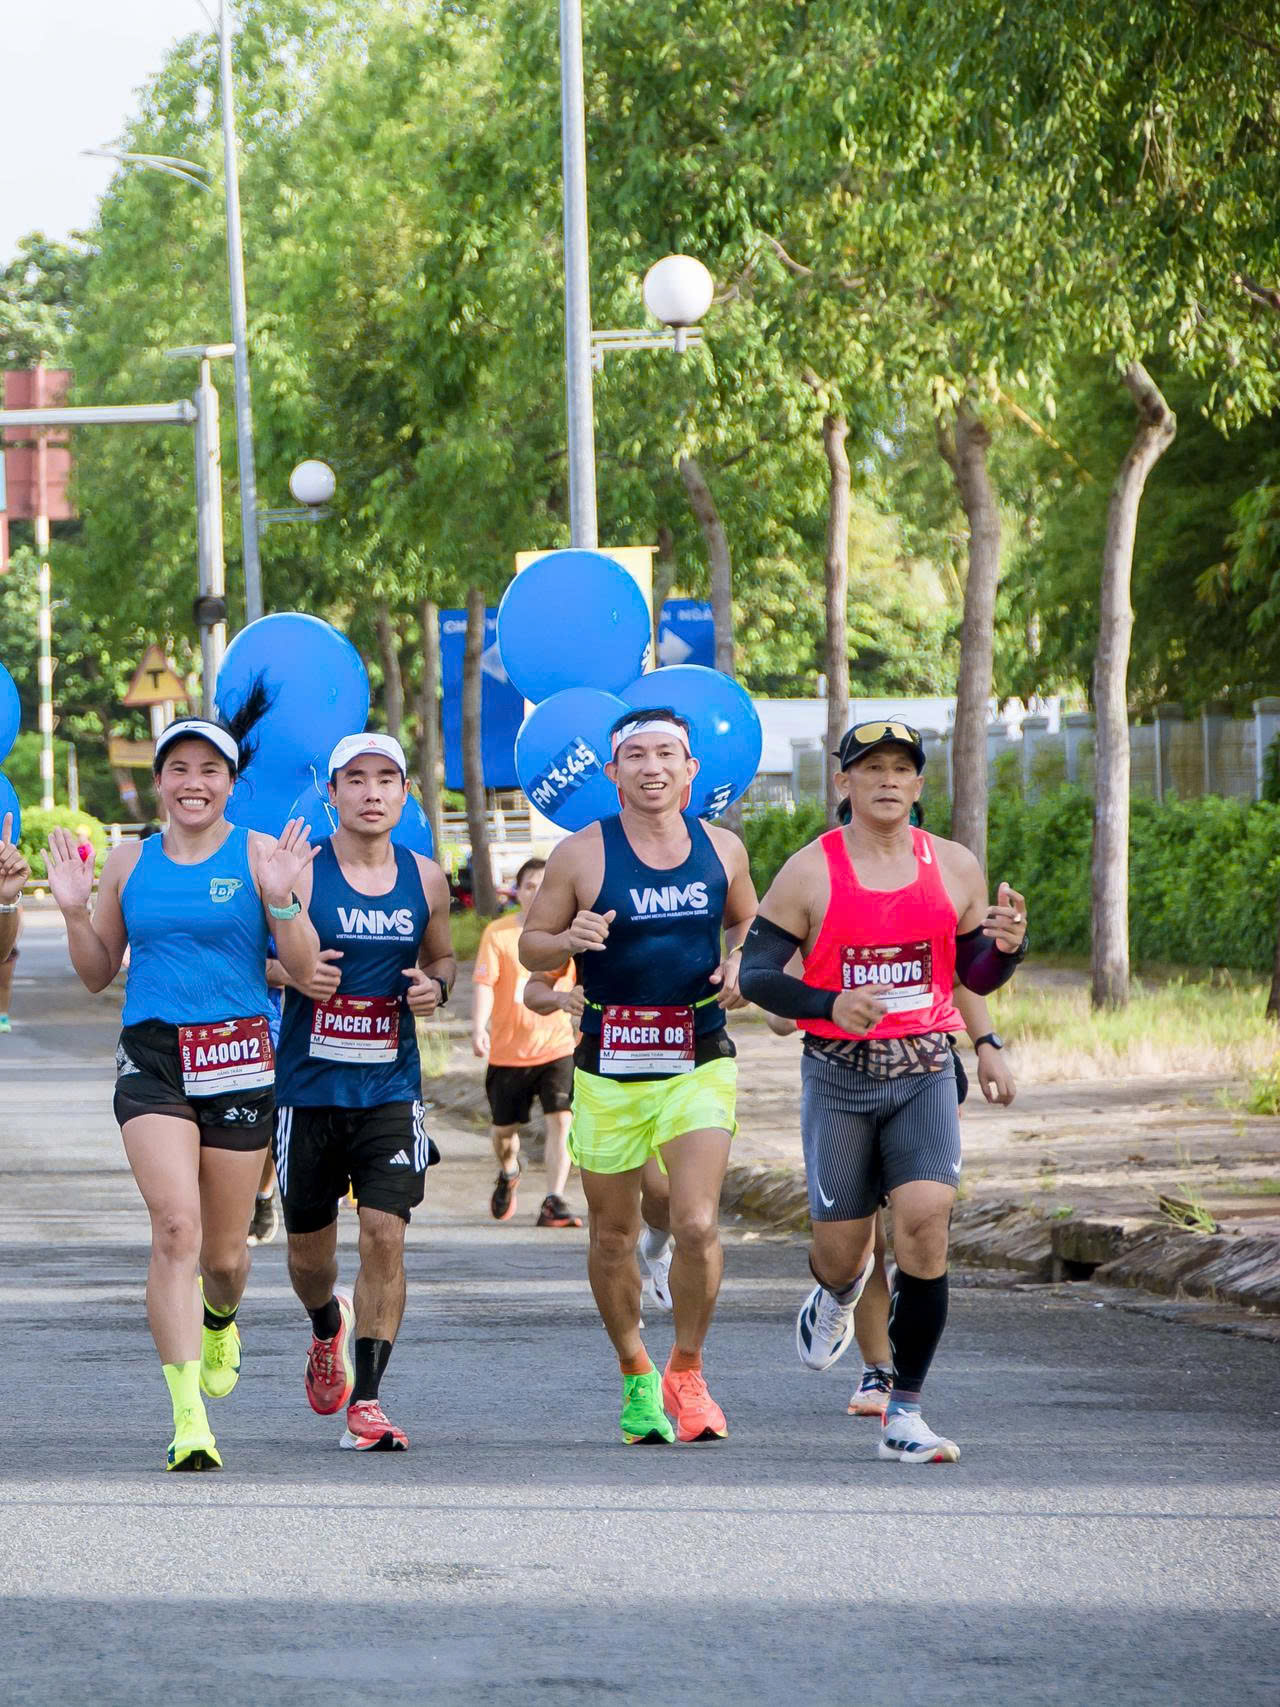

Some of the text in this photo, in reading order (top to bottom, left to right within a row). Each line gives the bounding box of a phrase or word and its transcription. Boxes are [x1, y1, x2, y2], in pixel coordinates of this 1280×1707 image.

[531, 744, 595, 809] FM 3:45
[629, 881, 709, 914] VNMS
[336, 907, 414, 935] VNMS
[842, 962, 851, 988] 42KM
[854, 960, 922, 985] B40076
[324, 1013, 390, 1033] PACER 14
[603, 1023, 611, 1049] 42KM
[611, 1026, 660, 1044] PACER
[664, 1027, 684, 1044] 08
[182, 1045, 192, 1071] 42KM
[195, 1037, 261, 1067] A40012
